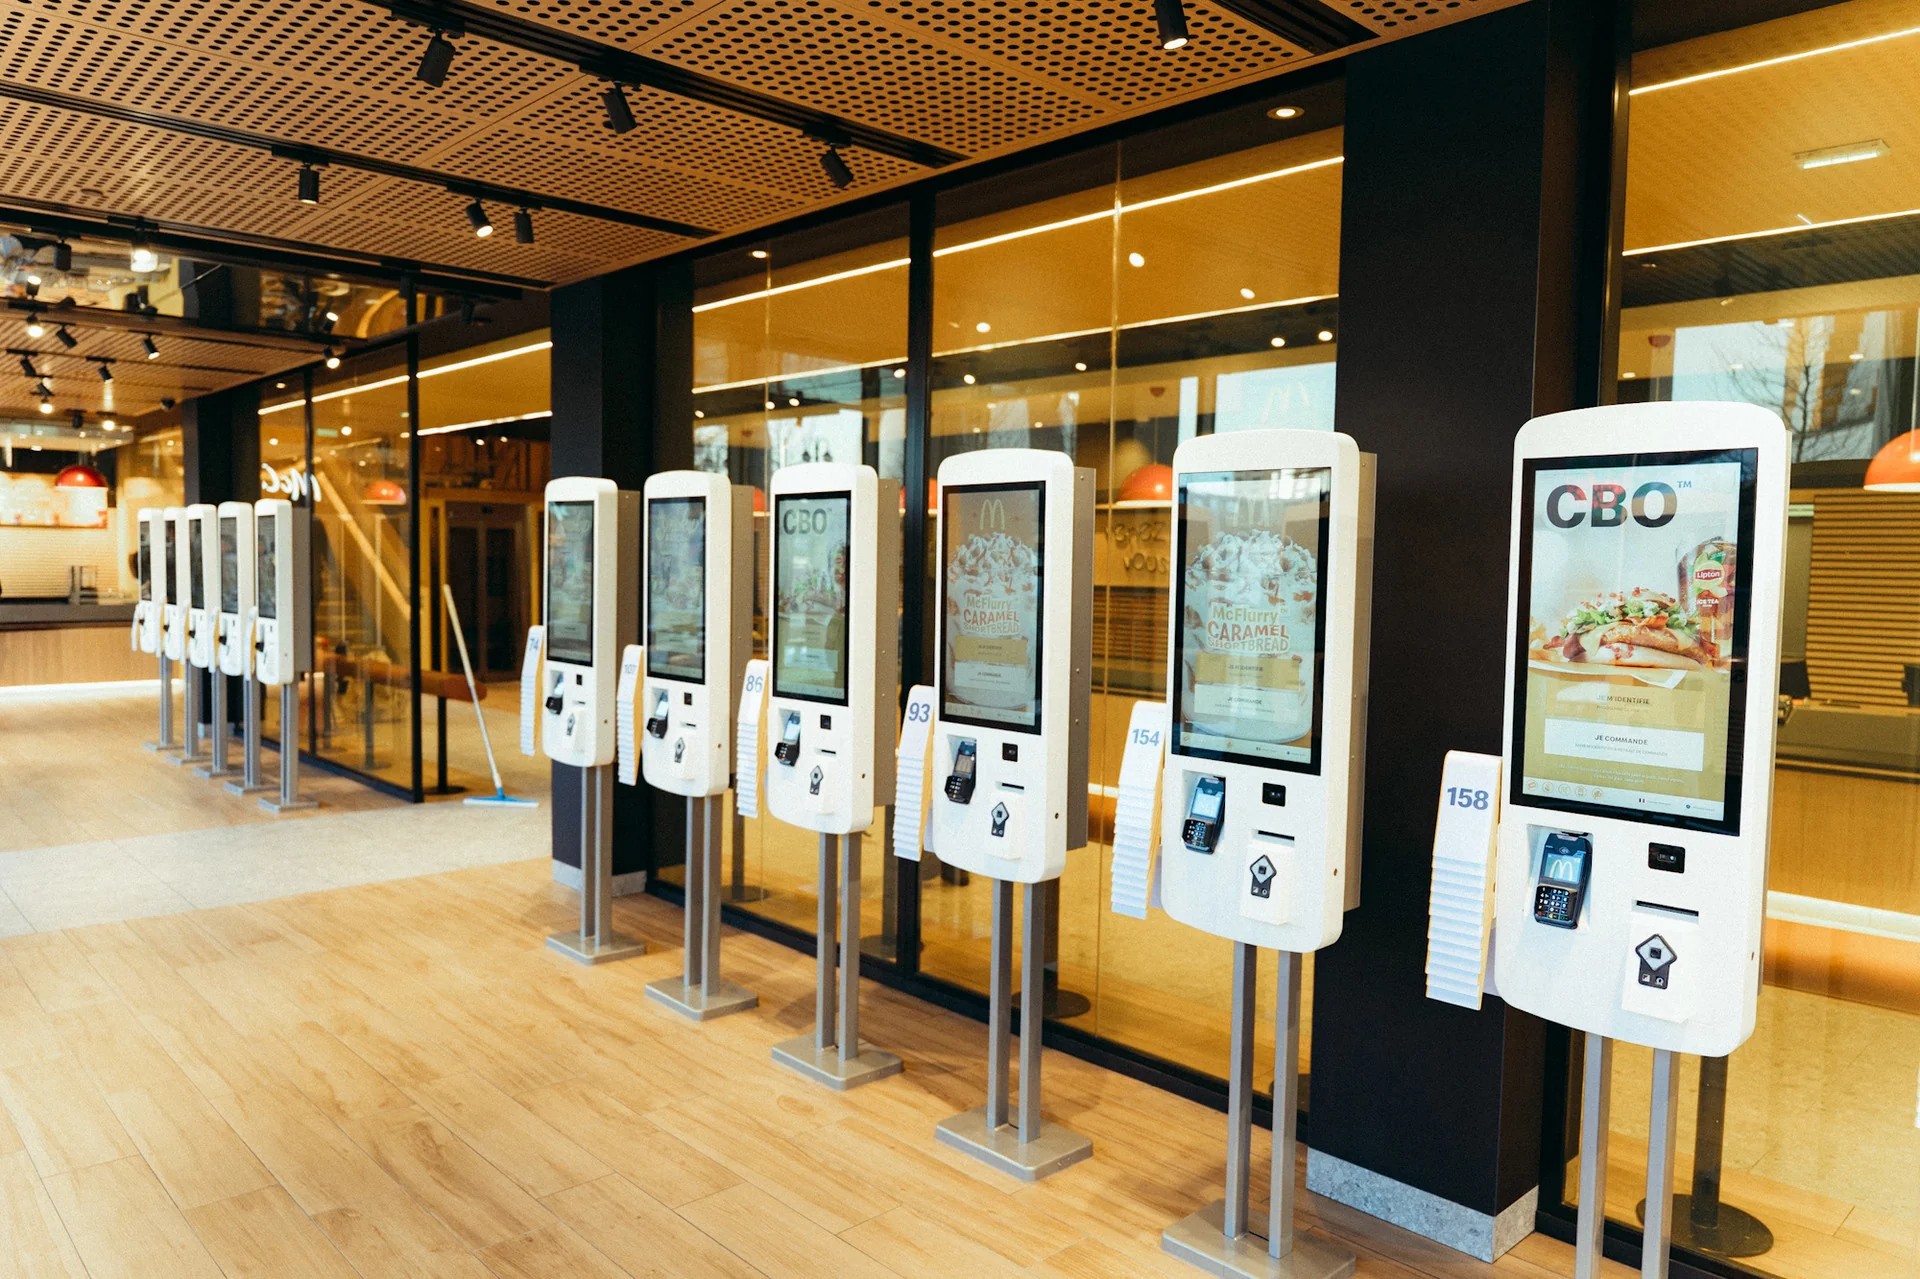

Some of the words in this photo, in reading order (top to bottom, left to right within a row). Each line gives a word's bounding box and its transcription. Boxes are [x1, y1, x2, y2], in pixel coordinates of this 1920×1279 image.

[1546, 481, 1678, 529] CBO
[783, 508, 827, 535] CBO
[966, 596, 1012, 611] McFlurry
[963, 609, 1020, 625] CARAMEL
[1212, 605, 1279, 626] McFlurry
[963, 621, 1020, 634] SHORTBREAD
[1207, 621, 1289, 644] CARAMEL
[1207, 637, 1289, 652] SHORTBREAD
[745, 675, 763, 693] 86
[1607, 696, 1650, 705] M'IDENTIFIE
[908, 702, 931, 723] 93
[1132, 728, 1160, 747] 154
[1604, 735, 1649, 746] COMMANDE
[1447, 787, 1489, 810] 158
